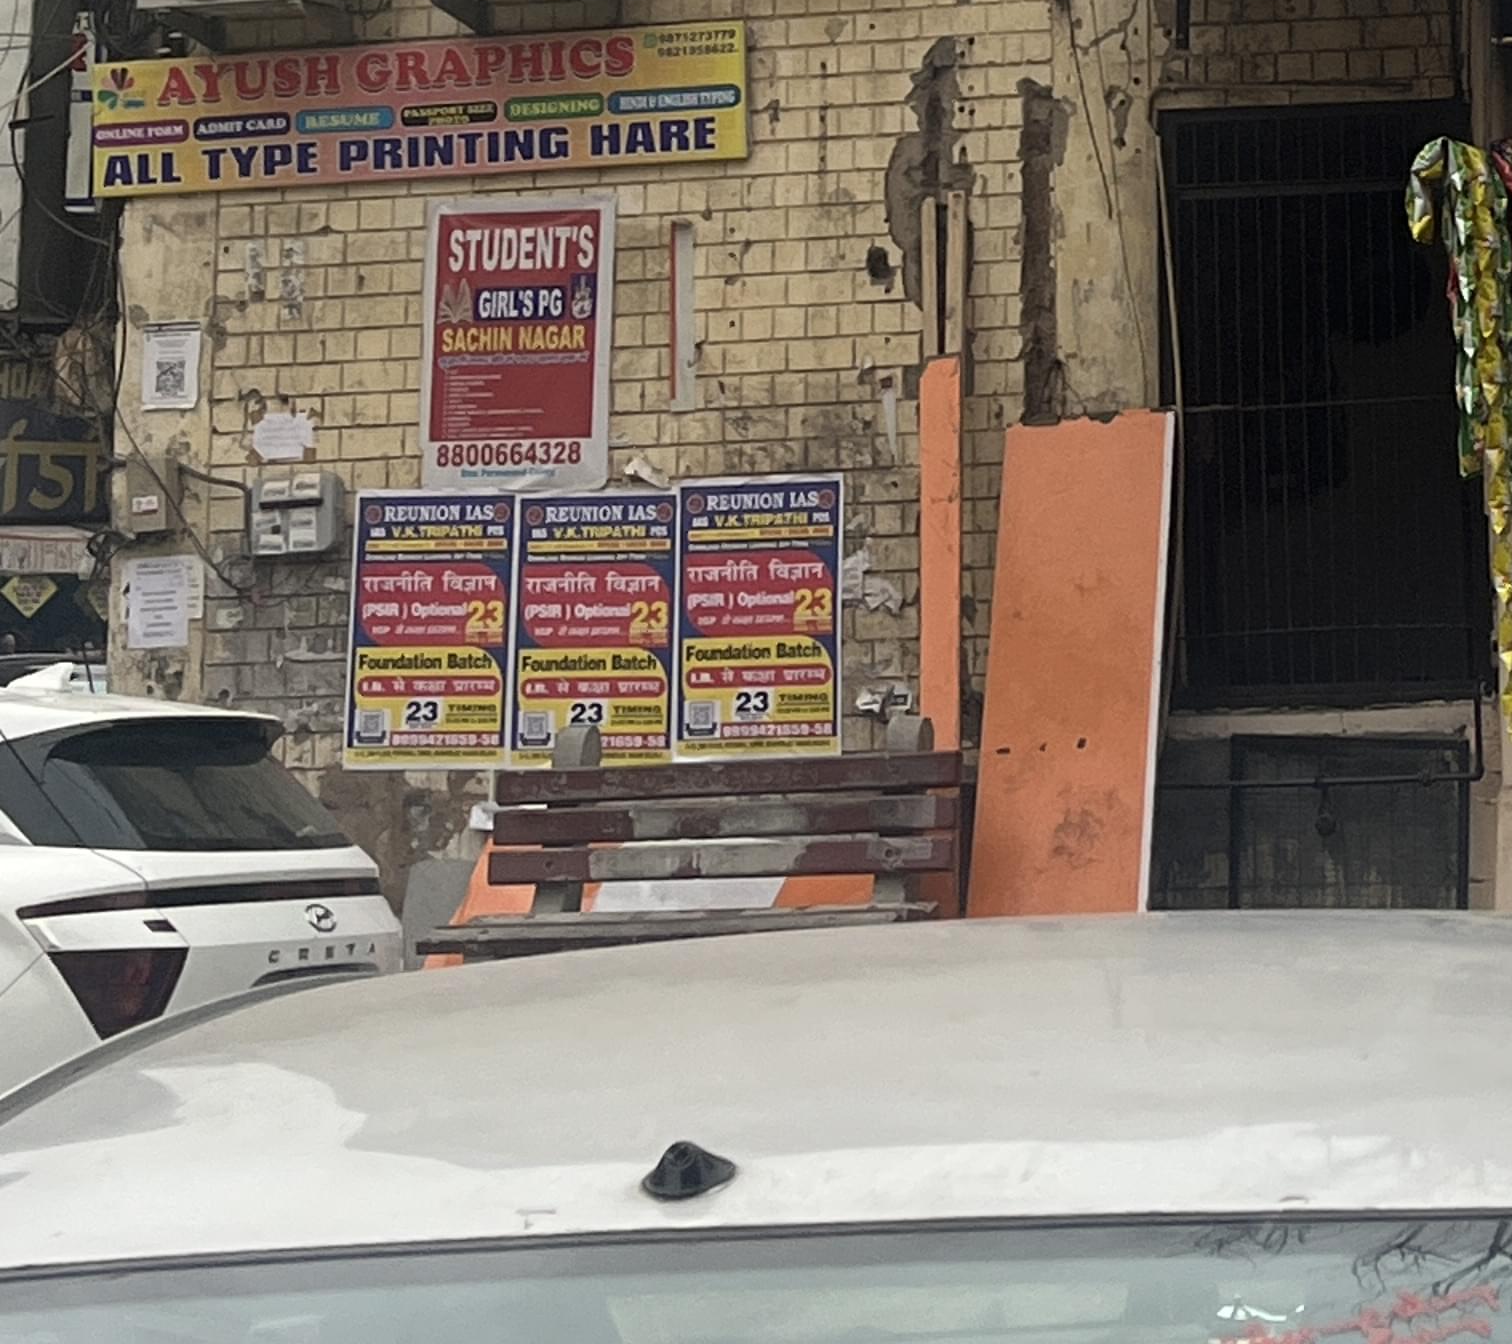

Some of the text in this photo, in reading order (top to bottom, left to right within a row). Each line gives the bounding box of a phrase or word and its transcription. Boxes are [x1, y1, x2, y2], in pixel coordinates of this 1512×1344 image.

[157, 36, 635, 108] AYUSH GRAPHICS
[510, 98, 600, 118] DESIGNING
[197, 116, 287, 135] ADMIT CARD
[304, 112, 381, 129] RESUME
[95, 124, 184, 140] ONLINE FORM
[103, 116, 718, 189] ALL TYPE PRINTING HARE
[449, 224, 594, 273] STUDENT'S
[478, 288, 563, 319] GIRL'S PG
[442, 324, 585, 353] SACHIN NAGAR
[437, 442, 582, 467] 8800664328
[706, 491, 819, 511] REUNION IAS
[384, 504, 494, 522] REUNION IAS
[546, 504, 656, 523] REUNION IAS
[687, 558, 825, 582] राजनीति विज्ञान
[362, 570, 434, 593] राजनीति
[526, 571, 661, 594] राजनीति विज्ञान
[411, 601, 467, 618] Optional
[737, 590, 795, 608] Optional
[794, 588, 832, 617] 23
[467, 600, 504, 629] 23
[574, 602, 631, 619] Optional
[631, 601, 668, 629] 23
[359, 653, 492, 670] Foundation Batch
[686, 642, 821, 661] Foundation Batch
[522, 655, 656, 672] Foundation Batch
[406, 701, 438, 723] 23
[736, 692, 769, 713] 23
[571, 703, 603, 724] 23
[268, 941, 377, 965] CRETA
